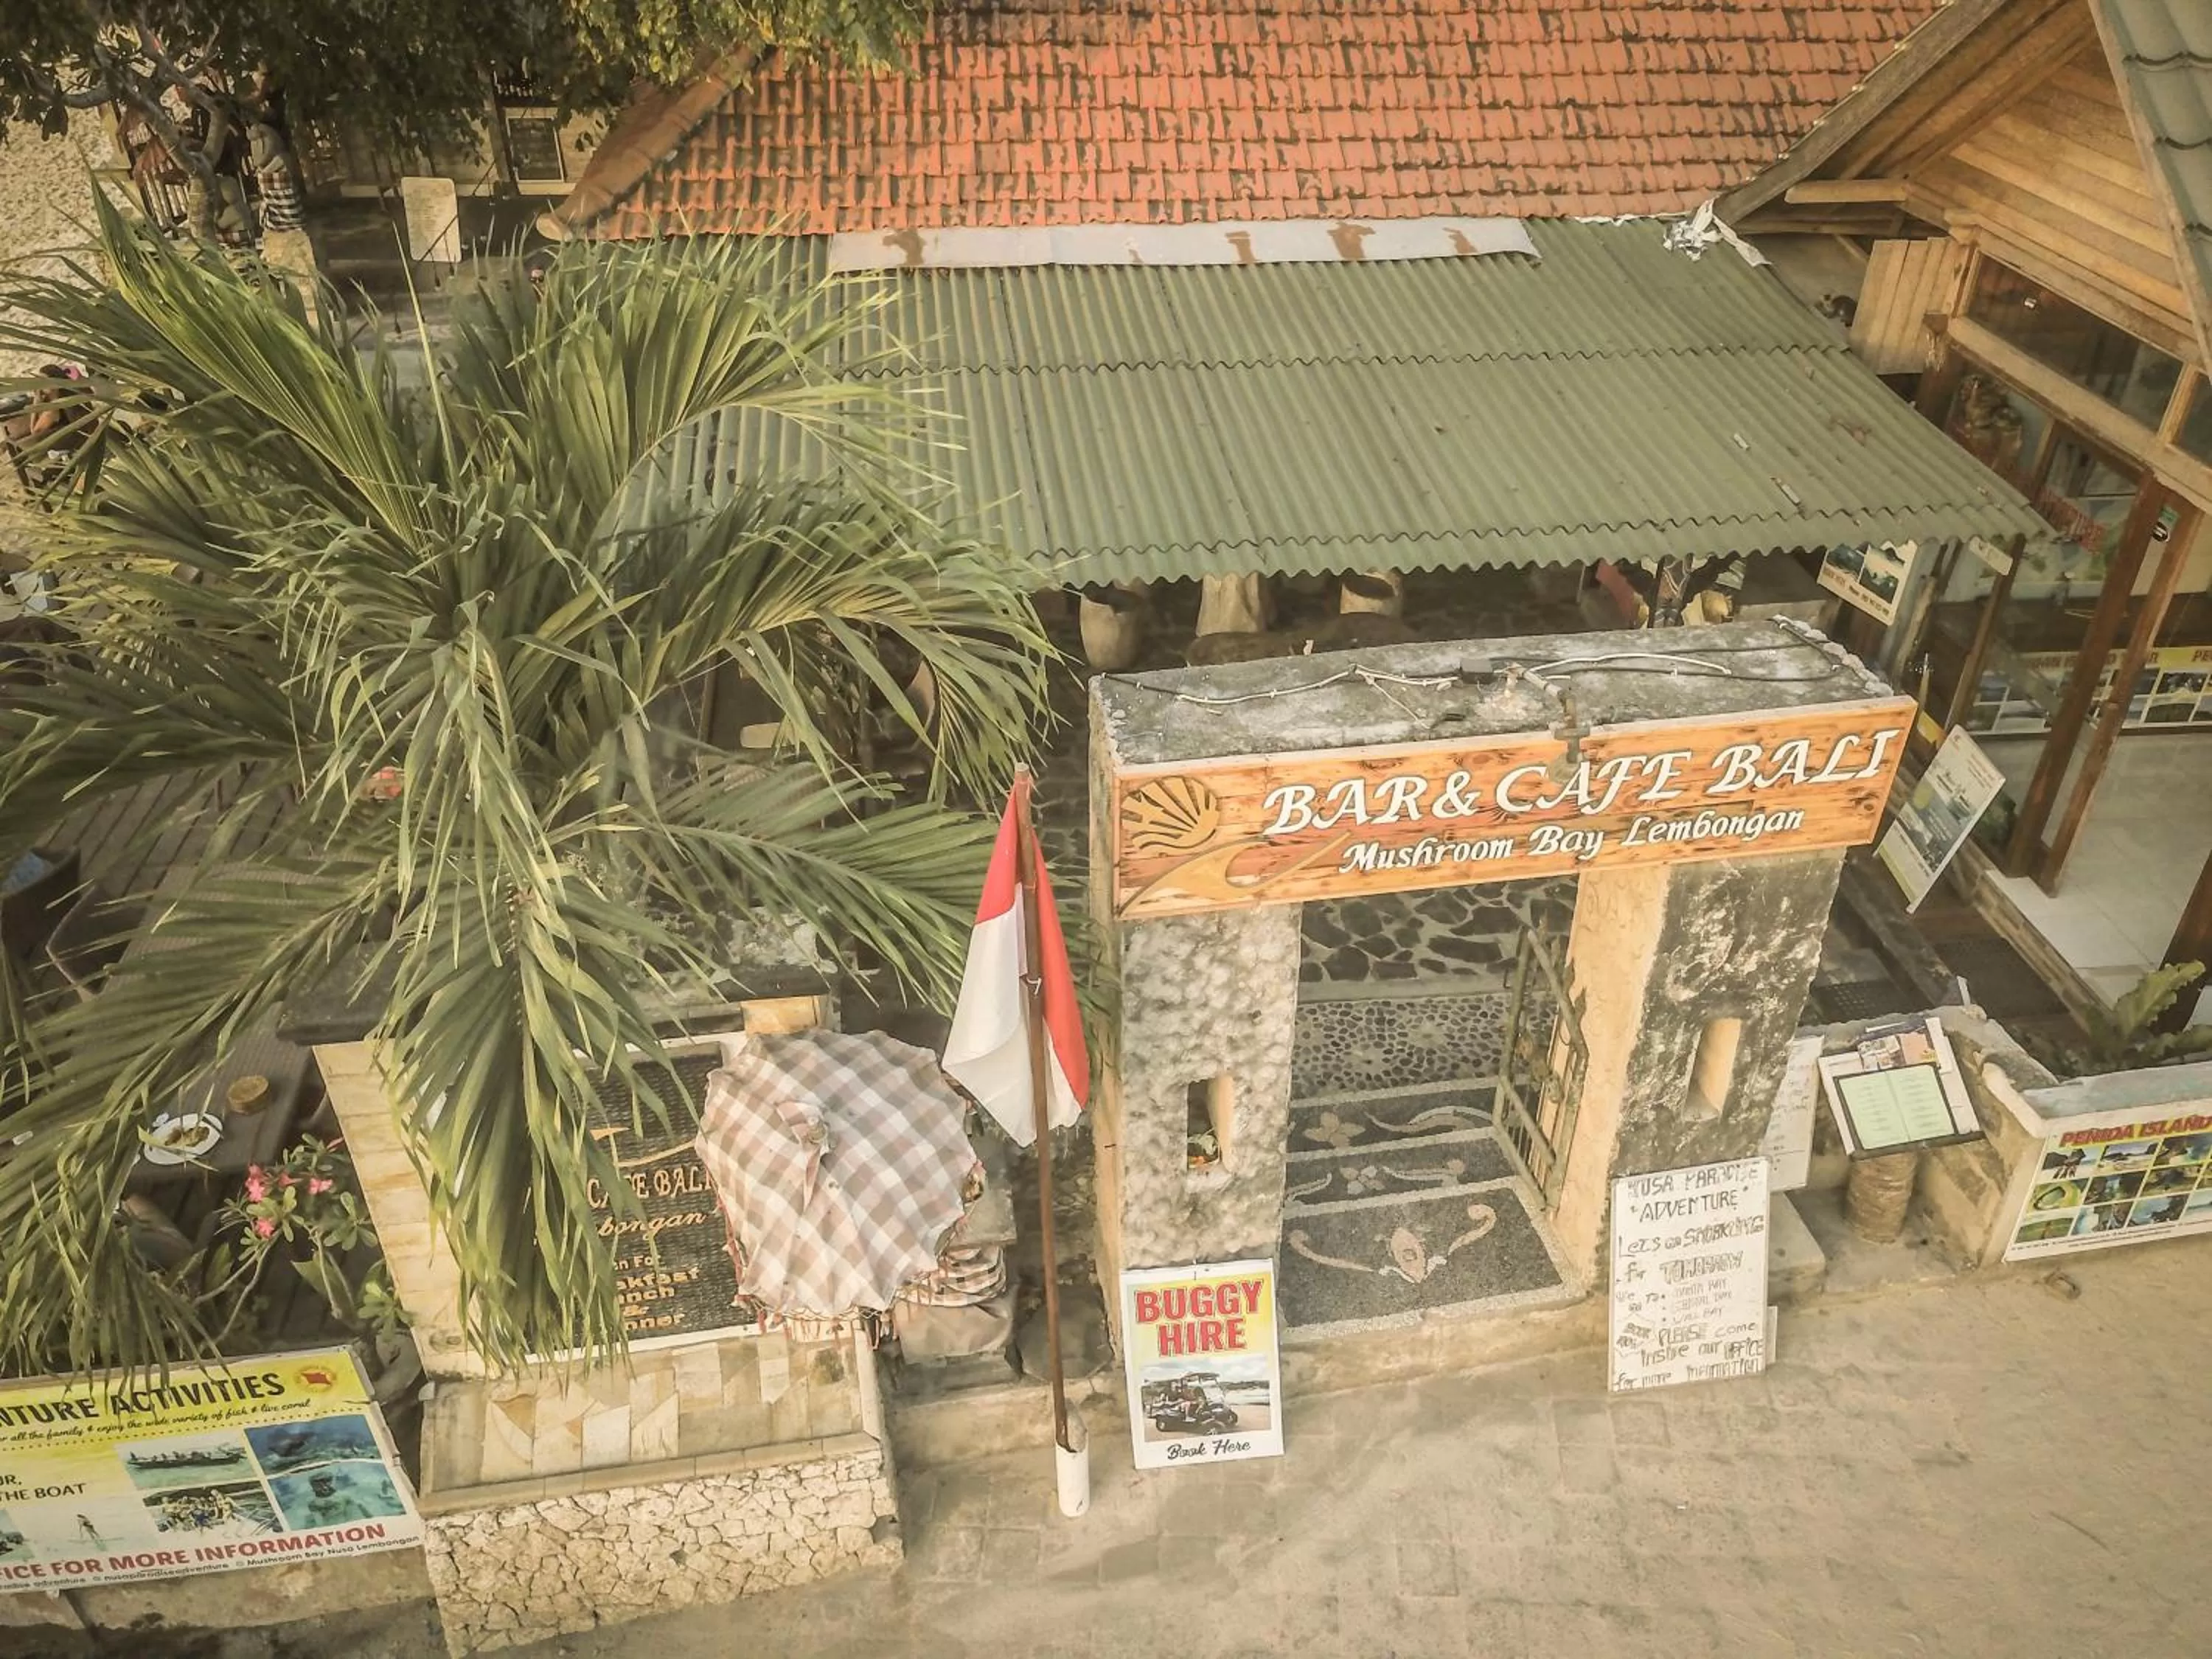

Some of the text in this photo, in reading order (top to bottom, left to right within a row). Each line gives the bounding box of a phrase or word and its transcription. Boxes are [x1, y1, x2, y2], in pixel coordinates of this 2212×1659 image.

[1495, 752, 1693, 814] CAFE
[1706, 728, 1901, 793] BALI
[1338, 808, 1806, 874] Mushroom Bay Lembongan
[2059, 1124, 2135, 1147] PENIDA
[586, 1172, 650, 1209] CE
[1134, 1279, 1265, 1324] BUGGY
[1158, 1317, 1248, 1357] HIRE
[110, 1372, 286, 1416] ACTIVITIES
[46, 1426, 84, 1440] family
[1166, 1438, 1252, 1461] Book Here
[35, 1483, 87, 1499] BOAT
[0, 1523, 386, 1581] ICE FOR MORE INFORMATION
